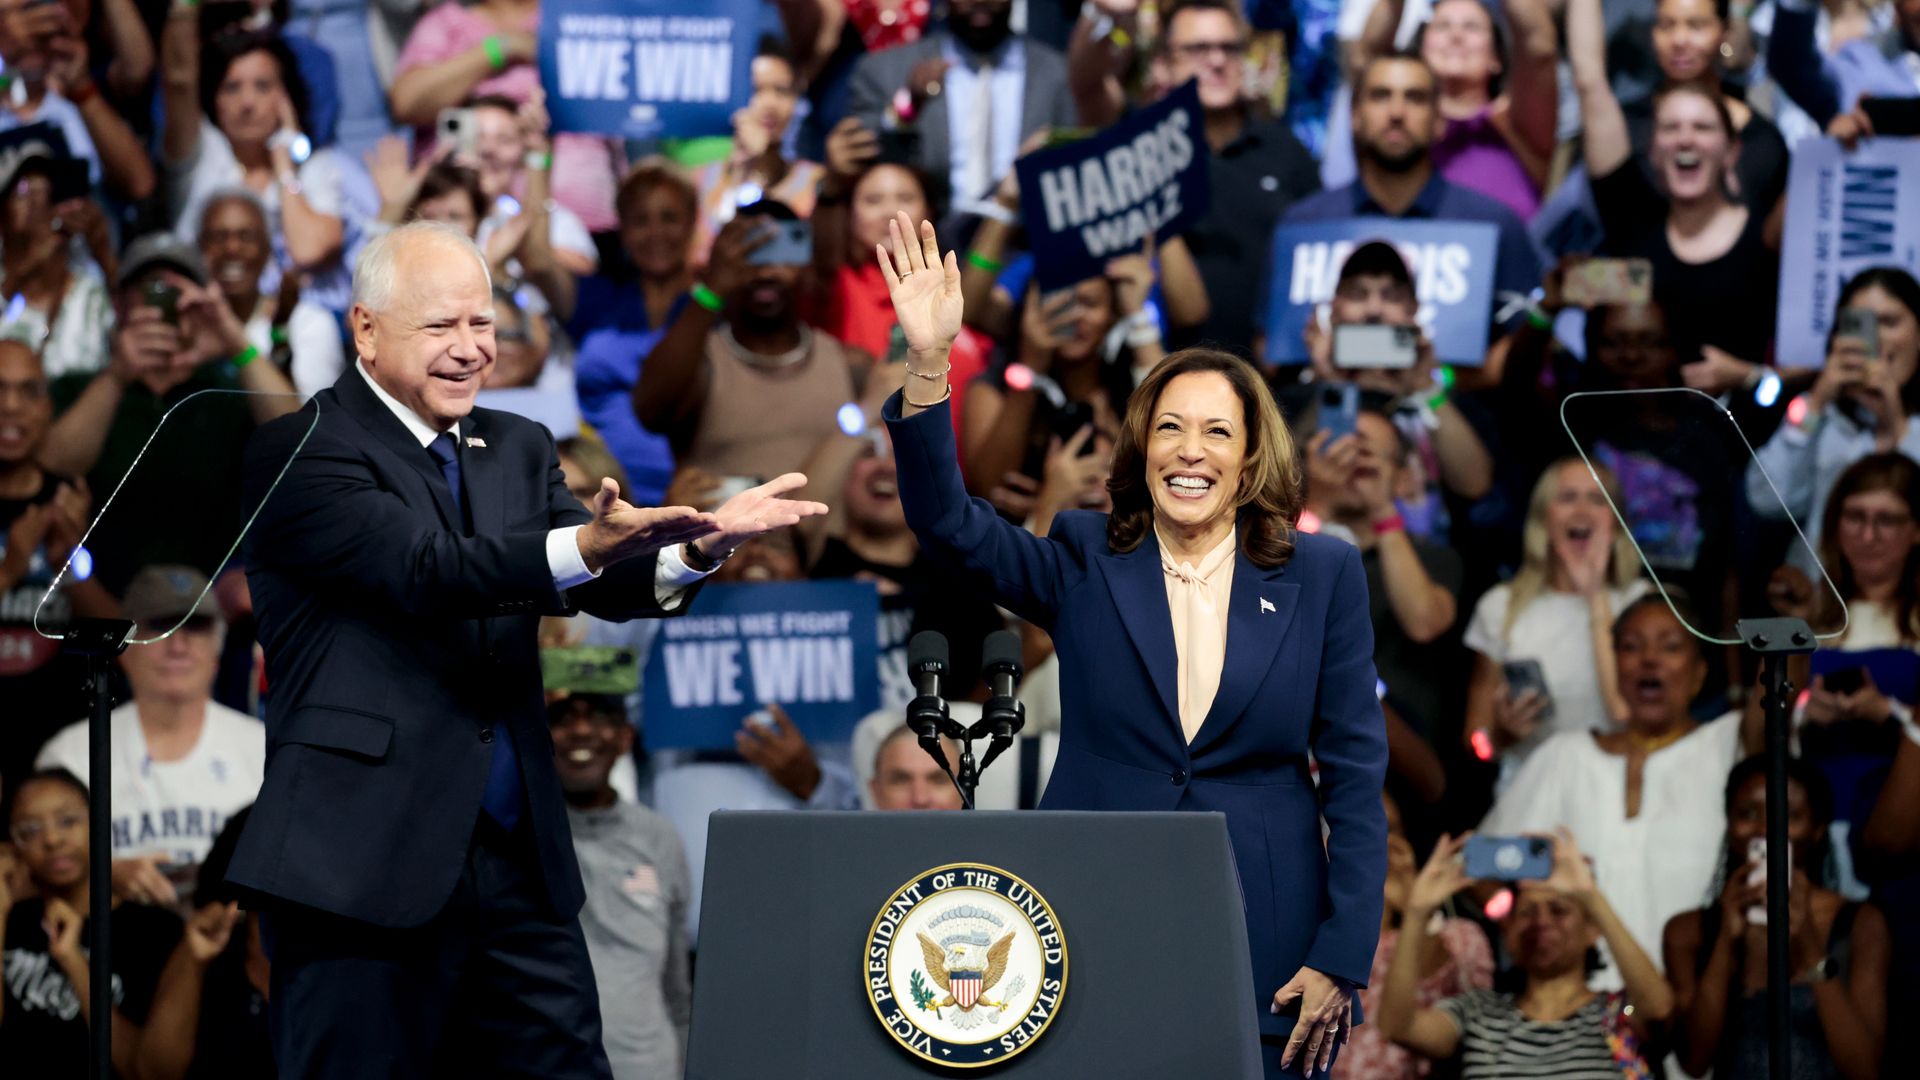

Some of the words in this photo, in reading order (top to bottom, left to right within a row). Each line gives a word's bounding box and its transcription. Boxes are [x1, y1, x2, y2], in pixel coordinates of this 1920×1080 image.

[556, 38, 630, 100] WE
[634, 41, 733, 102] WIN
[1039, 107, 1194, 233] HARRIS
[1081, 181, 1184, 258] WALZ
[1839, 165, 1899, 258] WIN
[664, 614, 737, 639] WHEN
[739, 612, 778, 637] WE
[781, 610, 851, 635] FIGHT
[663, 639, 743, 708] WE
[747, 636, 854, 703] WIN
[111, 806, 230, 849] HARRI
[932, 872, 956, 891] OF
[963, 871, 1000, 891] THE
[869, 882, 925, 1004] PRESIDENT
[1007, 882, 1063, 965] UNITED
[887, 1008, 933, 1057] VICE
[1000, 978, 1061, 1053] STATES
